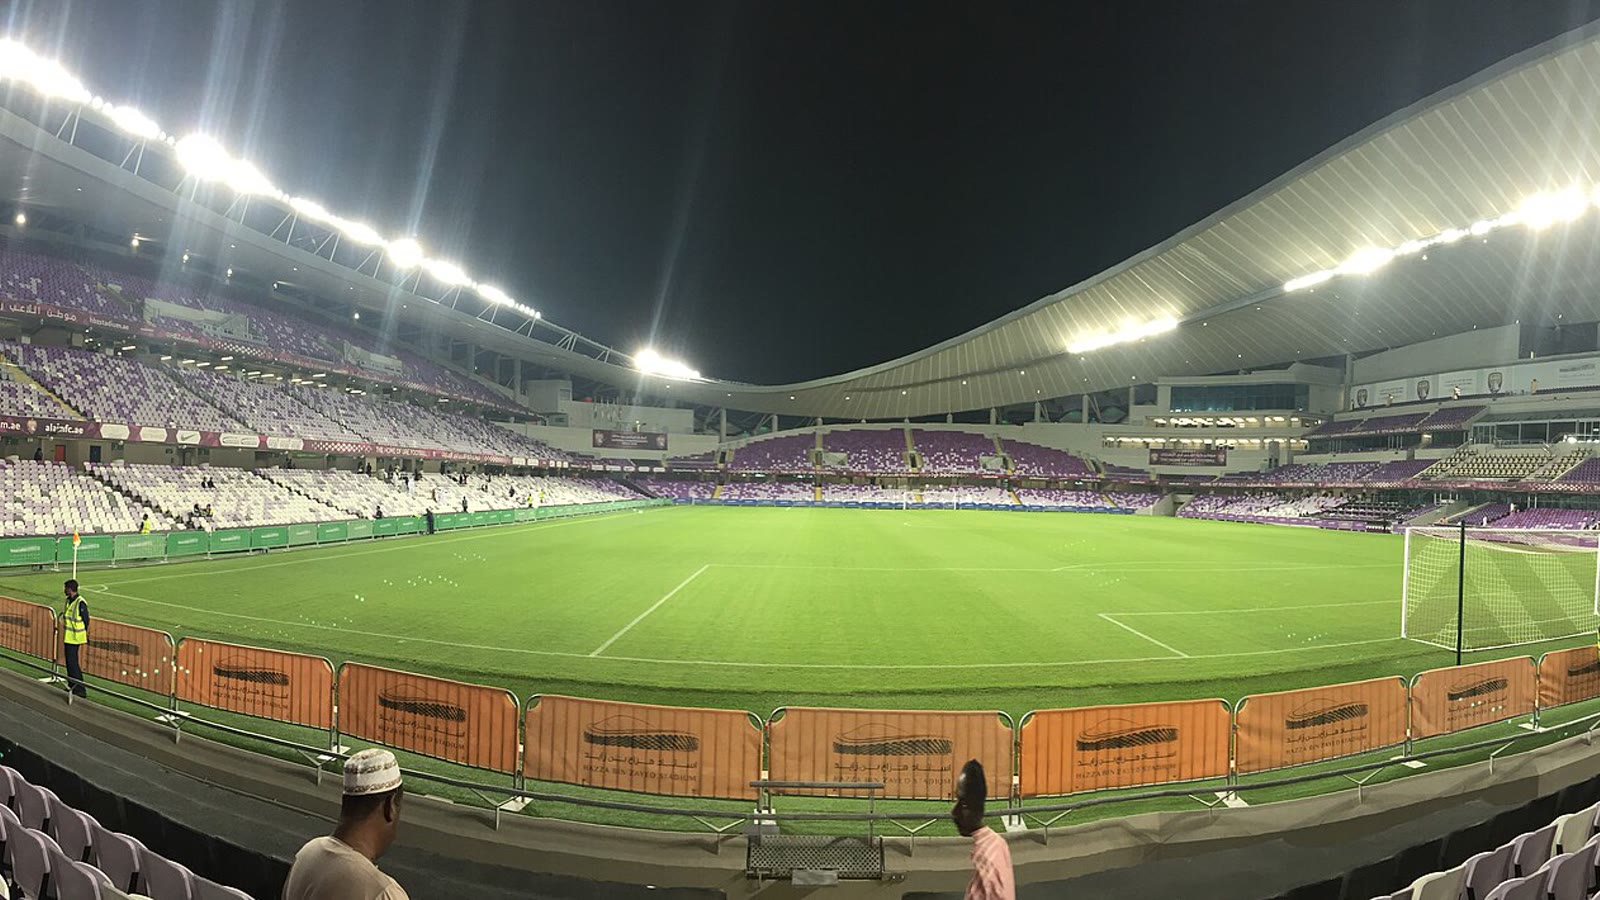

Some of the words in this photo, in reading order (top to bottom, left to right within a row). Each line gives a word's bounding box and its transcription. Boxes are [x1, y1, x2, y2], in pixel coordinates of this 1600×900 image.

[583, 764, 609, 774] HAZZA
[612, 768, 626, 776] BIN
[629, 769, 657, 779] ZAYED
